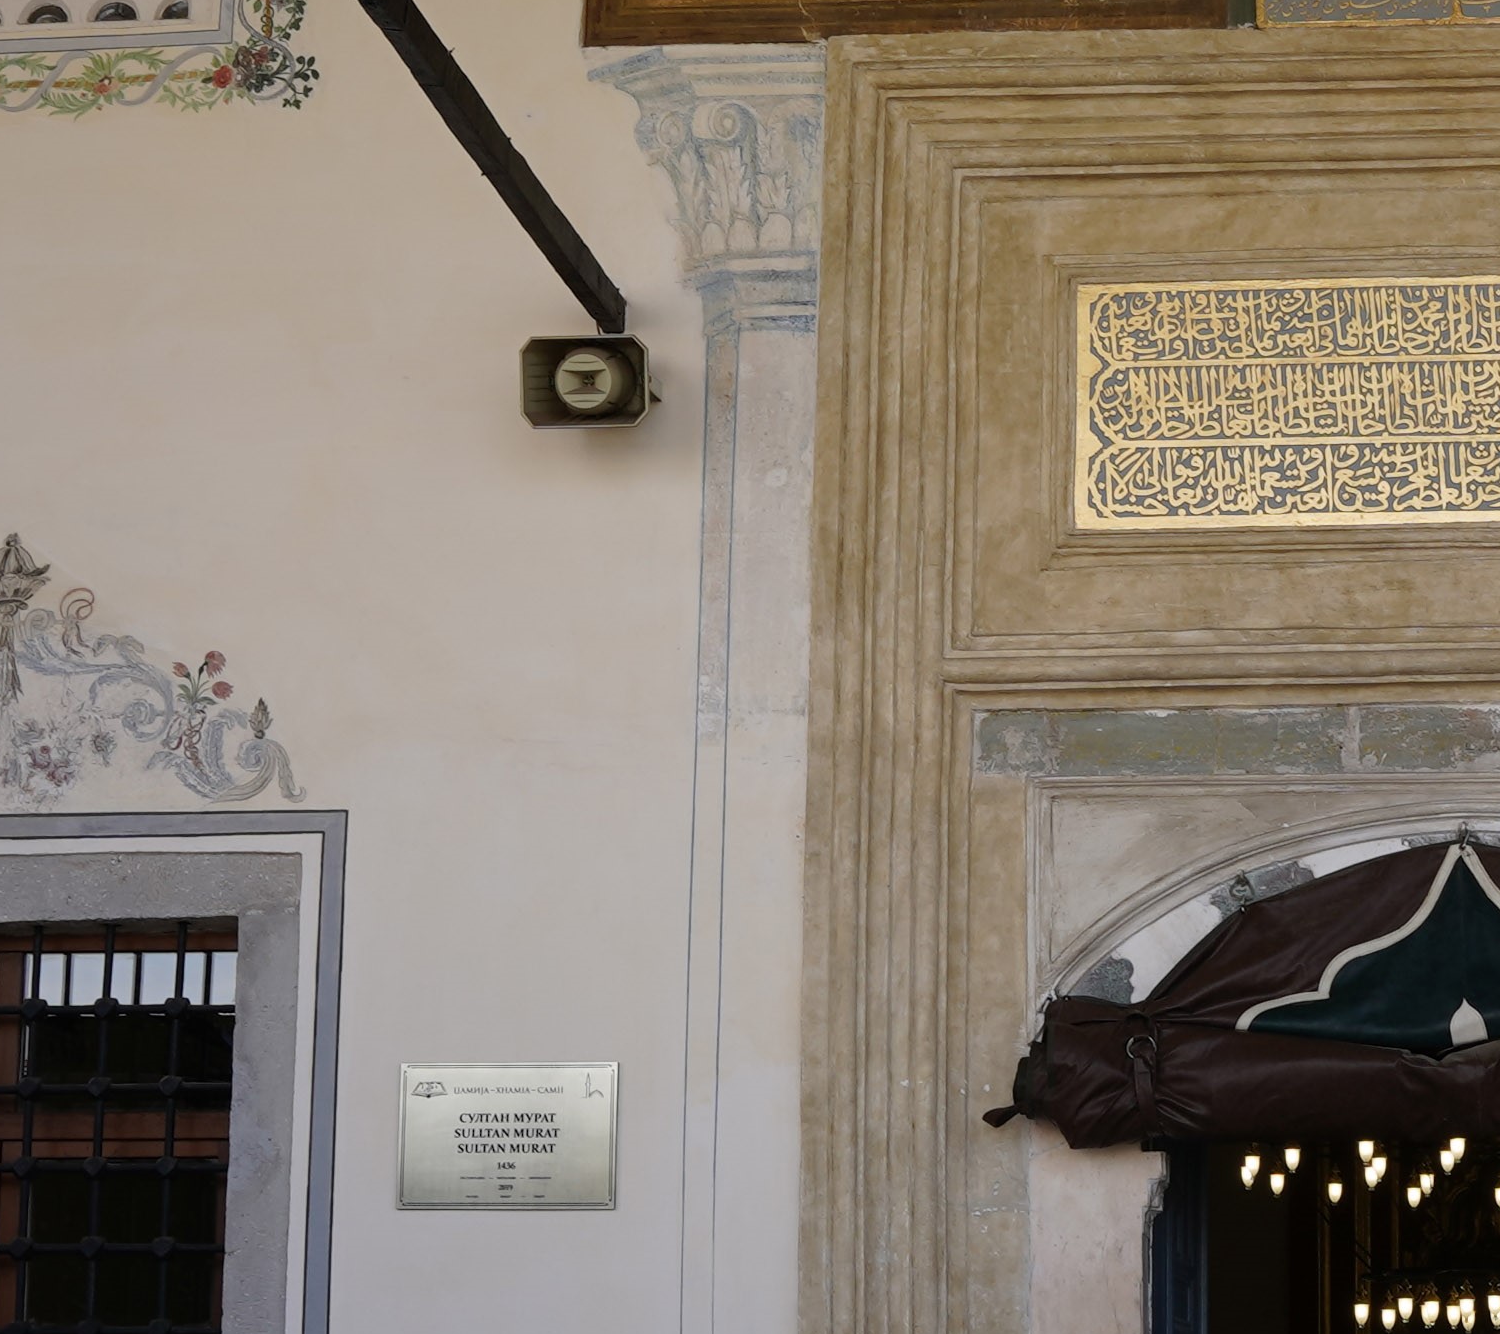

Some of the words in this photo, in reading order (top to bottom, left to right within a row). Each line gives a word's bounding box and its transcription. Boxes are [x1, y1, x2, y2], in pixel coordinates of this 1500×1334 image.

[459, 1112, 510, 1124] СУЛТАН
[513, 1112, 557, 1124] МУРАТ
[454, 1128, 510, 1139] SULLTAN
[513, 1127, 561, 1139] MURAT
[457, 1143, 506, 1154] SULTAN
[509, 1143, 556, 1154] MURAT
[497, 1161, 516, 1170] 1436
